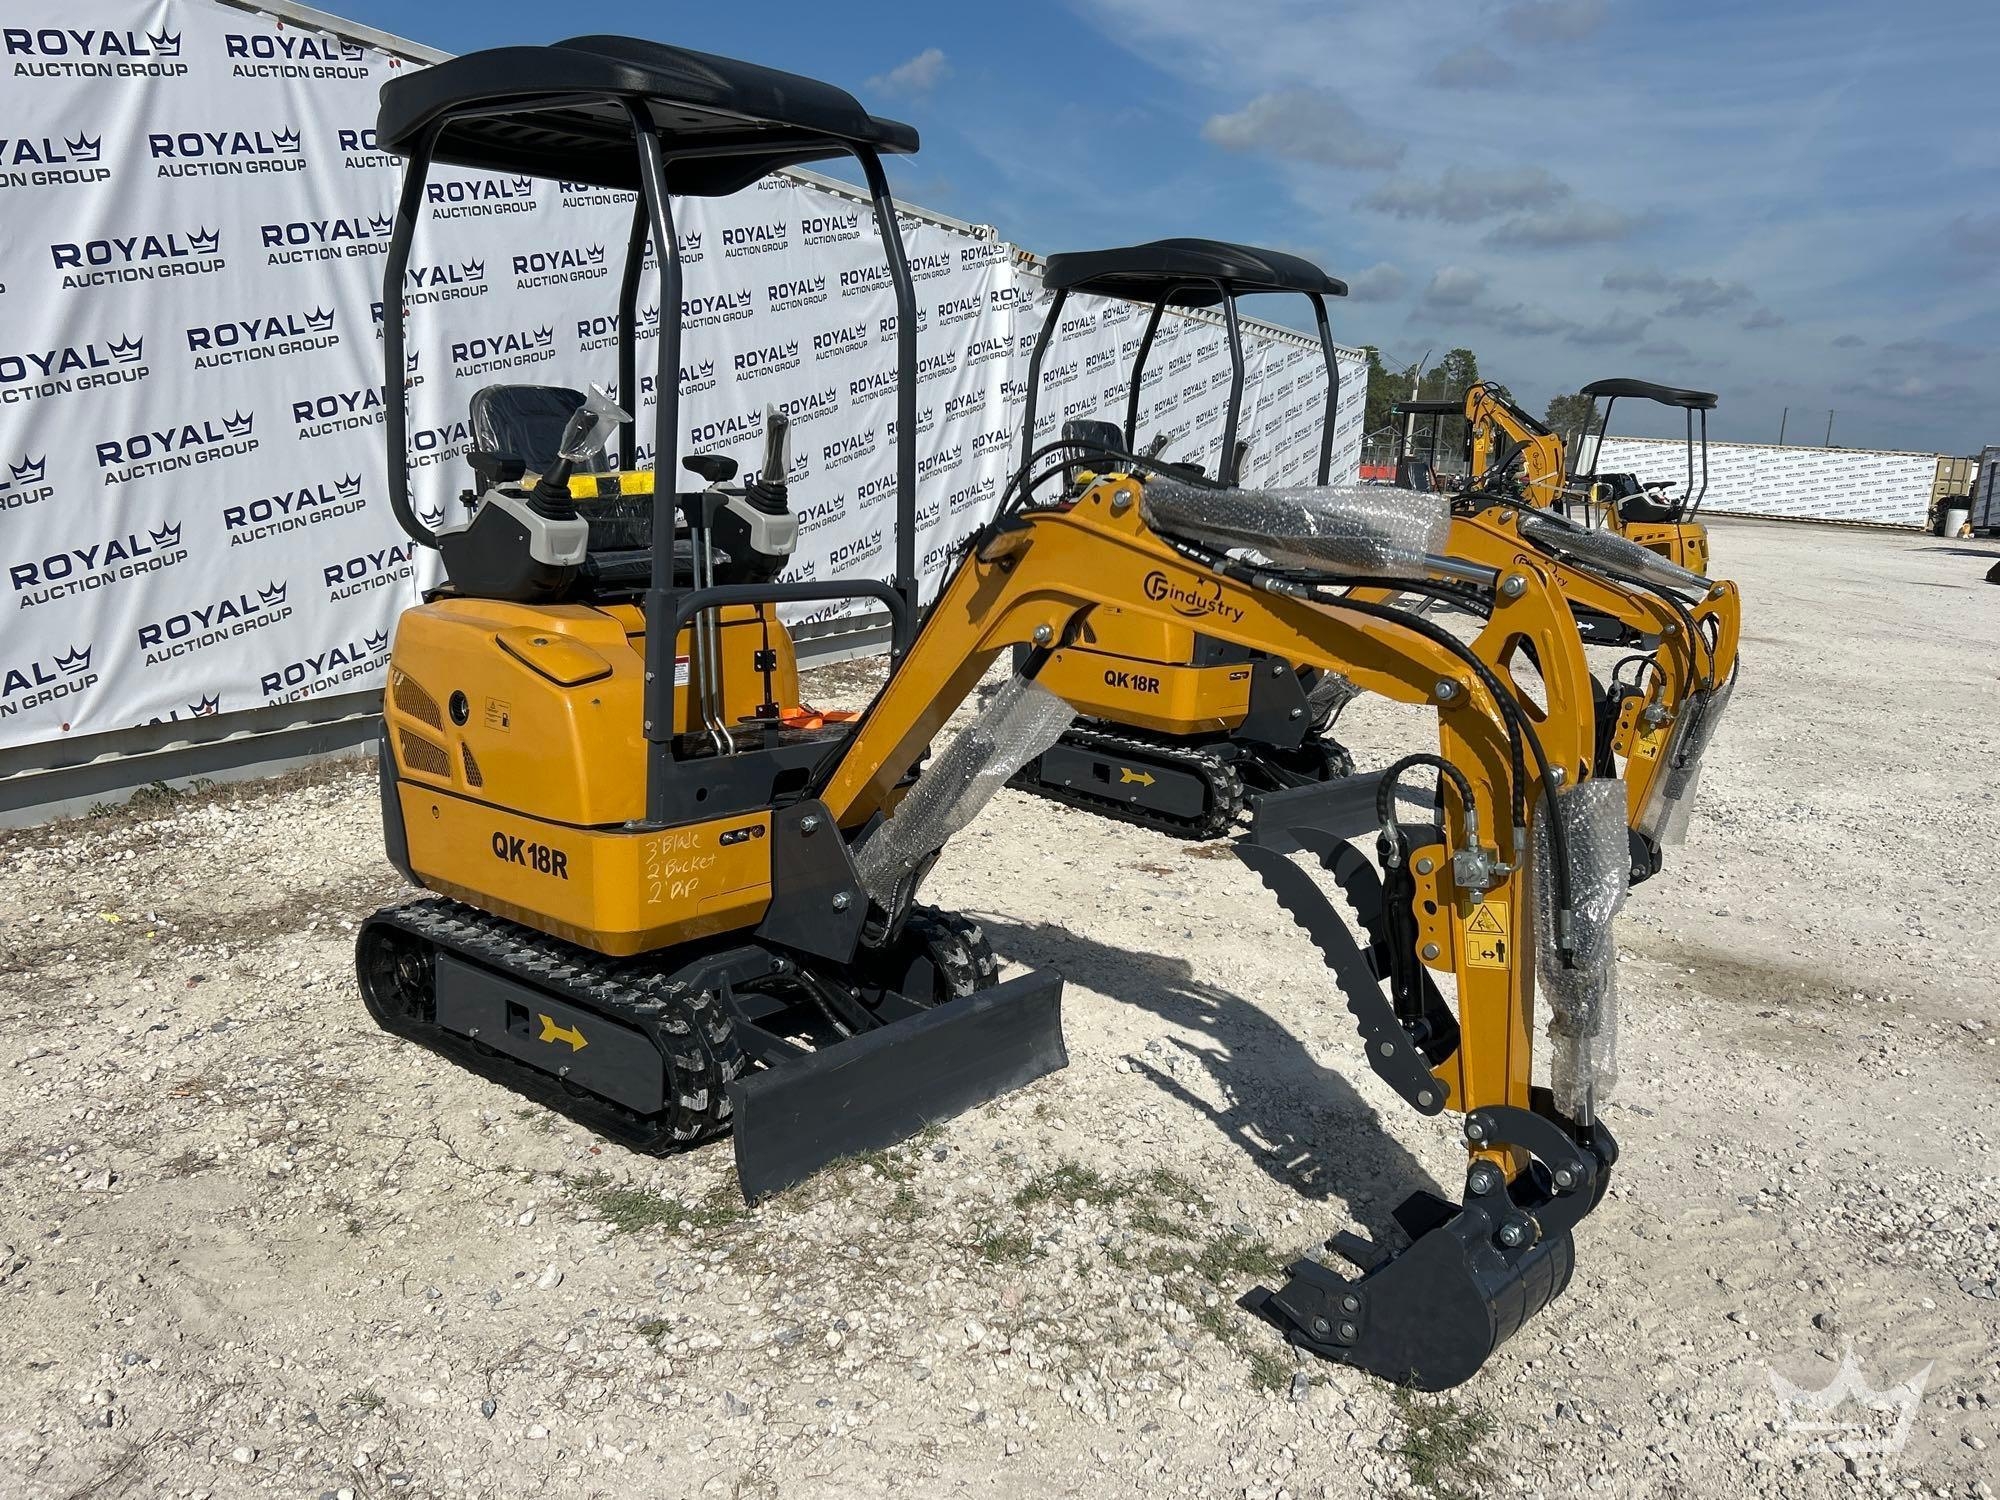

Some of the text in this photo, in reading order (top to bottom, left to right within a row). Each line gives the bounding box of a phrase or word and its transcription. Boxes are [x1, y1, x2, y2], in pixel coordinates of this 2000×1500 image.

[3, 29, 151, 56] ROYAL
[225, 35, 340, 60] ROYAL
[14, 63, 188, 76] AUCTION GROUP
[233, 65, 368, 79] AUCTION GROUP
[149, 132, 267, 158] ROYAL
[158, 159, 306, 177] AUCTION GROUP
[345, 152, 403, 168] AUCTIO
[32, 169, 110, 185] GROUP
[758, 178, 793, 190] AUCTION
[427, 180, 514, 203] ROYAL
[563, 191, 640, 208] AUCTION GROU
[433, 202, 536, 219] AUCTION GROUP
[261, 218, 371, 247] ROYAL
[723, 225, 775, 245] ROYAL
[802, 216, 849, 234] ROYAL
[901, 221, 922, 232] GROUP
[726, 242, 788, 257] AUCTION GROUP
[805, 232, 860, 245] AUCTION GROUP
[50, 234, 189, 269] ROYAL
[268, 240, 393, 265] AUCTION GROU
[513, 248, 588, 274] ROYAL
[961, 245, 995, 262] ROYAL
[63, 259, 225, 289] AUCTION GROUP
[517, 268, 607, 289] AUCTION GROUP
[840, 266, 884, 286] ROYAL
[442, 285, 488, 300] GROUP
[768, 279, 816, 300] ROYAL
[842, 284, 873, 296] AUCTION
[680, 293, 738, 319] ROYAL
[771, 294, 827, 312] AUCTION GROUP
[939, 298, 974, 316] ROYAL
[187, 313, 307, 351] ROYAL
[680, 310, 753, 332] AUCTION GROUP
[452, 332, 536, 363] ROYAL
[814, 327, 860, 350] ROYAL
[816, 340, 867, 360] AUCTION GROUP
[968, 338, 1004, 357] ROYAL
[0, 342, 110, 382] OYAL
[195, 336, 339, 369] AUCTION GROUP
[456, 350, 555, 378] AUCTION GROUP
[735, 344, 788, 370] ROYAL
[77, 367, 149, 390] GROUP
[736, 359, 800, 381] AUCTION GROUP
[939, 366, 957, 377] GROUP
[686, 380, 716, 394] GROUP
[850, 372, 892, 395] ROYAL
[779, 392, 828, 418] ROYAL
[852, 391, 878, 405] AUCTION
[945, 392, 979, 414] ROYAL
[814, 405, 838, 418] GROUP
[299, 415, 372, 440] AUCTION
[692, 414, 748, 444] ROYAL
[972, 427, 1011, 450] ROYAL
[96, 418, 225, 467] ROYAL
[692, 429, 763, 458] AUCTION GROUP
[824, 434, 866, 460] ROYAL
[105, 440, 258, 486] AUCTION GROUP
[825, 446, 875, 470] AUCTION GROUP
[918, 449, 954, 473] ROYAL
[858, 473, 898, 500] ROYAL
[950, 482, 984, 506] ROYAL
[224, 481, 337, 530] ROYAL
[860, 491, 890, 509] AUCTION
[232, 500, 366, 546] AUCTION GROUP
[797, 500, 837, 527] OYAL
[826, 512, 845, 524] GROUP
[10, 534, 153, 590] ROYAL
[830, 536, 873, 565] ROYAL
[832, 548, 882, 575] AUCTION GROUP
[20, 550, 187, 609] AUCTION GROUP
[330, 572, 397, 602] AUCTION
[138, 591, 261, 649] ROYAL
[146, 607, 292, 666] AUCTION GROUP
[261, 639, 368, 696] ROYAL
[342, 653, 393, 681] GROUP
[22, 674, 98, 709] GROUP
[1104, 670, 1160, 694] QK18R
[492, 831, 569, 880] QK18R
